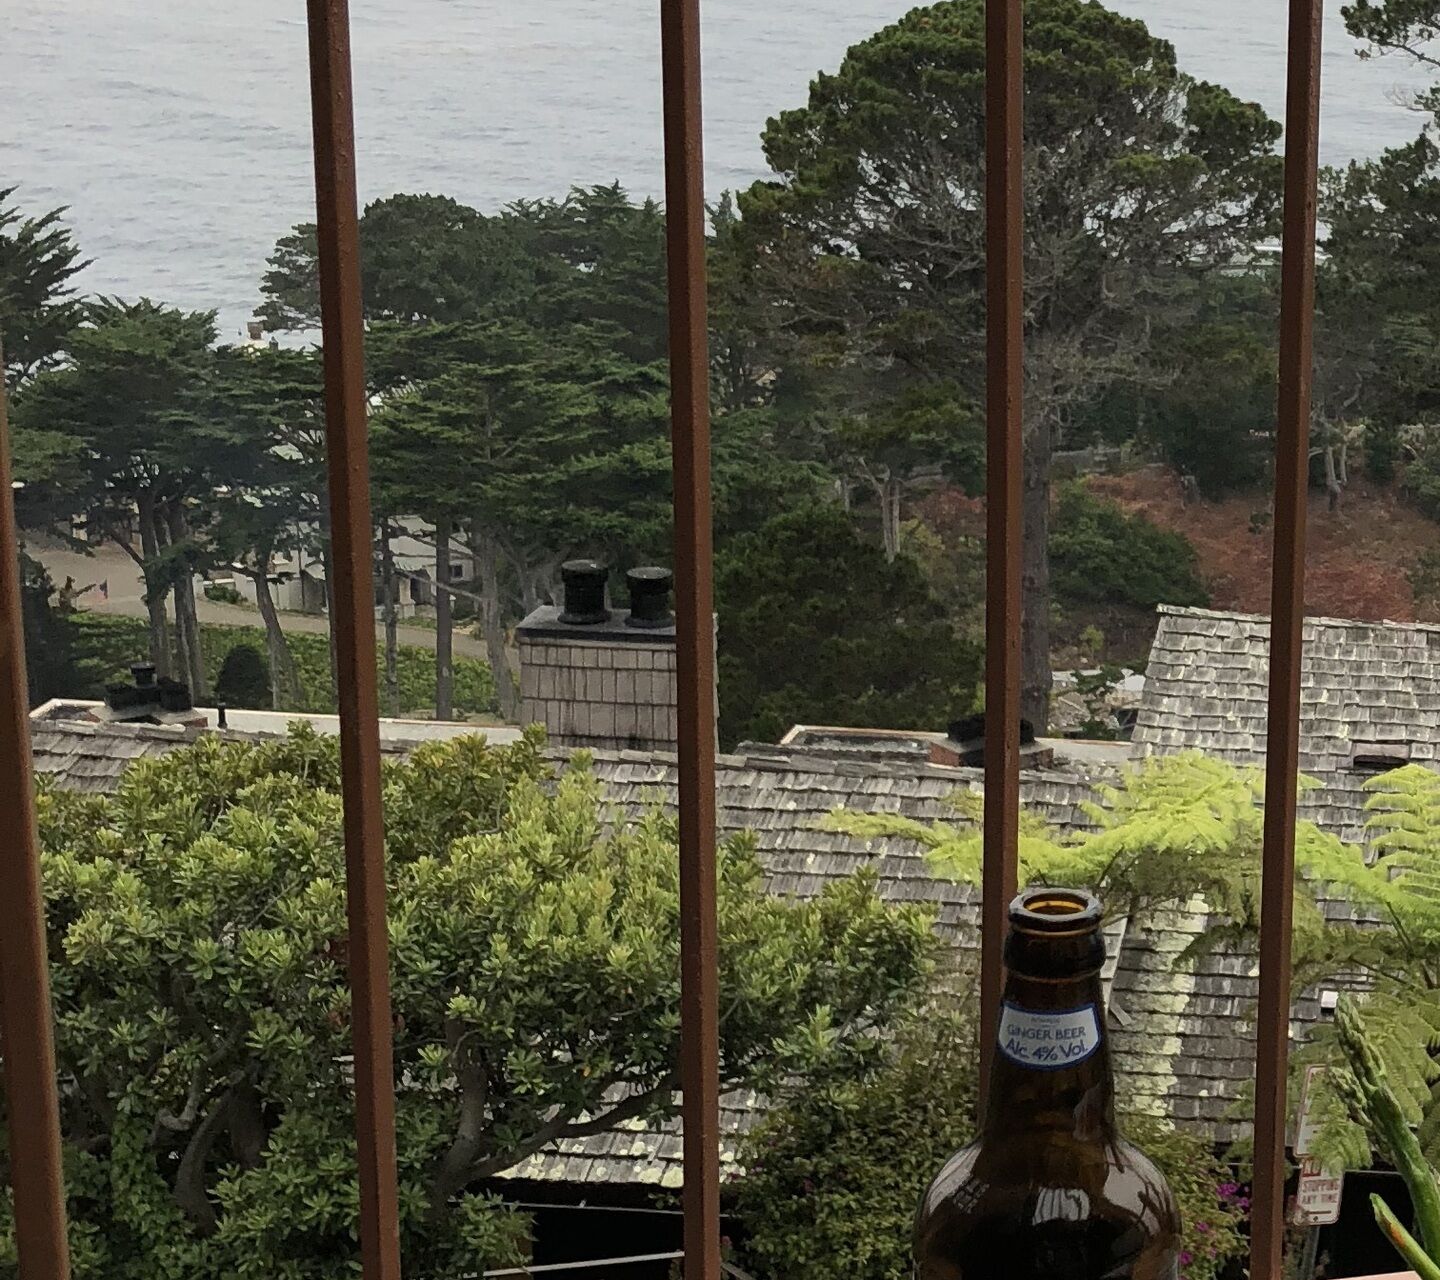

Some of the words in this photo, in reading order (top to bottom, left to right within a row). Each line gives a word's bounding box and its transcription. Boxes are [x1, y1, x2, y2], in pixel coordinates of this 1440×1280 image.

[1006, 1023, 1053, 1040] GINGER
[1056, 1026, 1087, 1040] BEER
[1032, 1045, 1059, 1062] 4%
